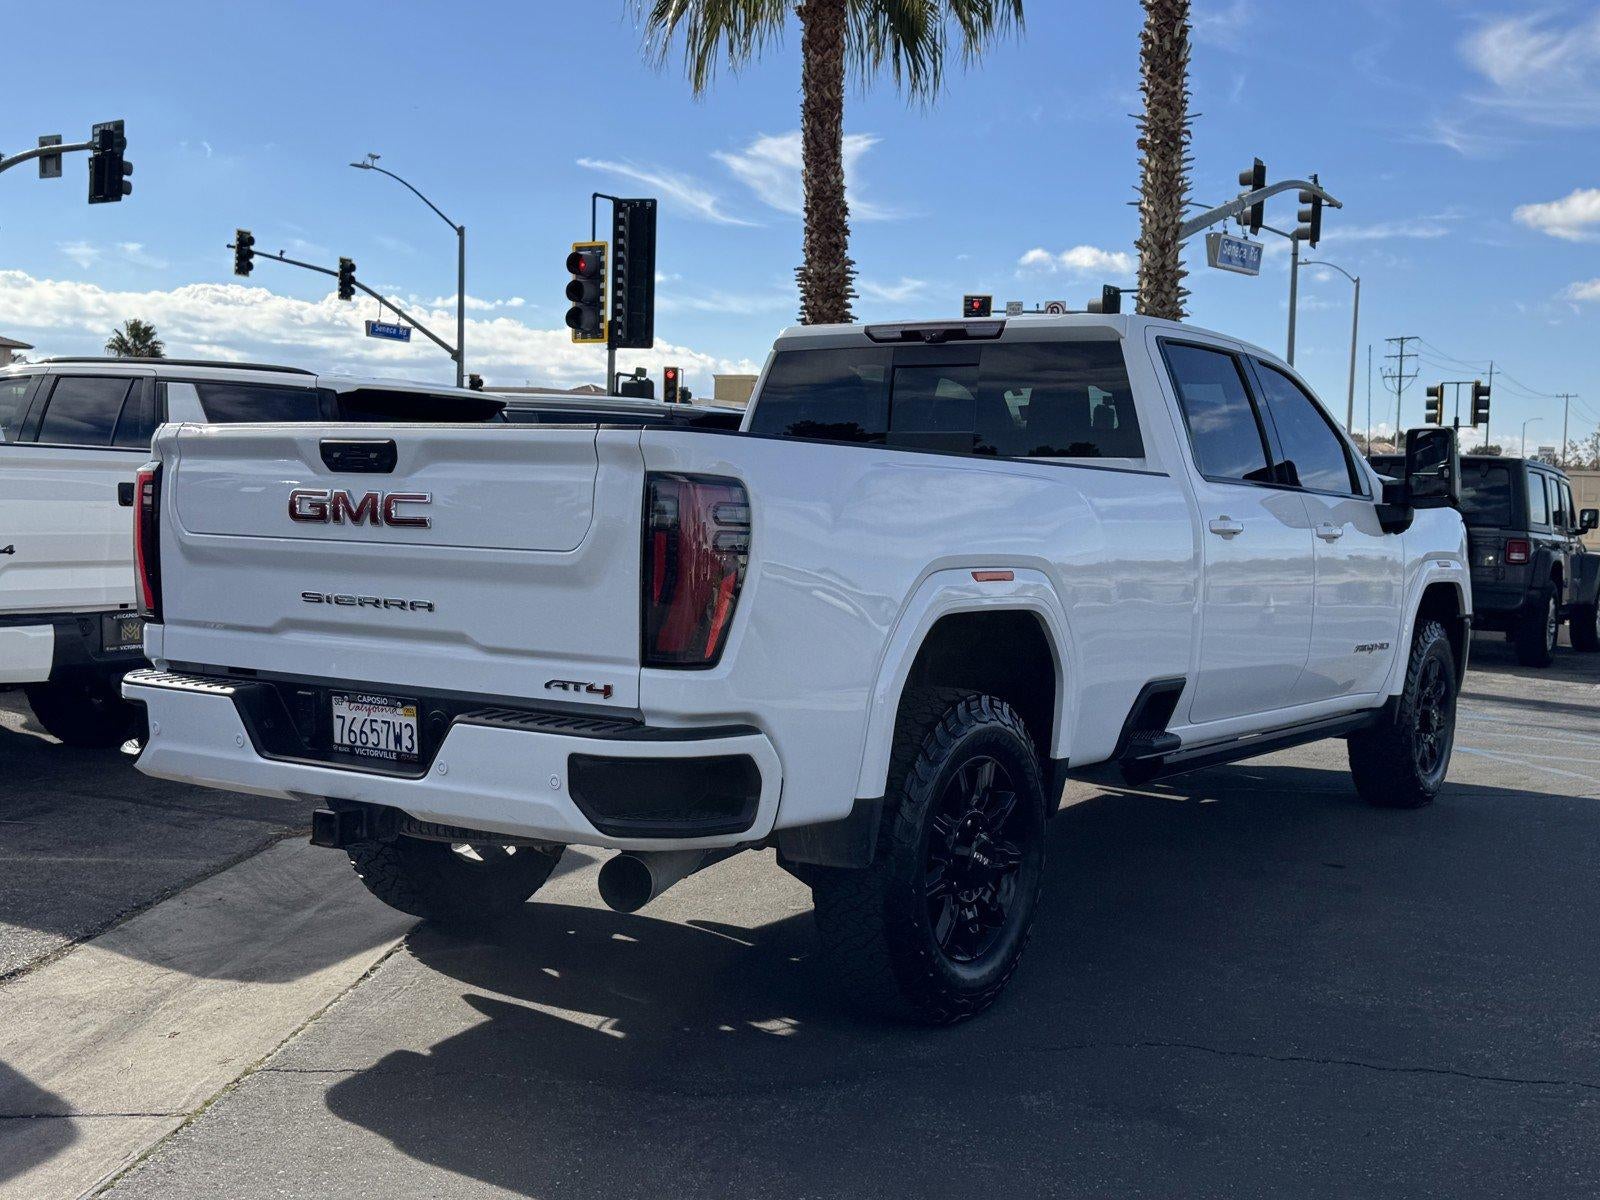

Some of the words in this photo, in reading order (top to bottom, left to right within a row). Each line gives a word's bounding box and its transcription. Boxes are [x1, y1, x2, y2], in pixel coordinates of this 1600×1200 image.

[375, 325, 397, 334] Seneca
[288, 488, 432, 529] GMC
[301, 590, 436, 613] SIERRA
[544, 679, 613, 699] AT4
[357, 695, 387, 704] CAPOSIO
[349, 702, 403, 717] California
[336, 715, 414, 752] 76657W3
[355, 747, 397, 759] VICTORVILLE
